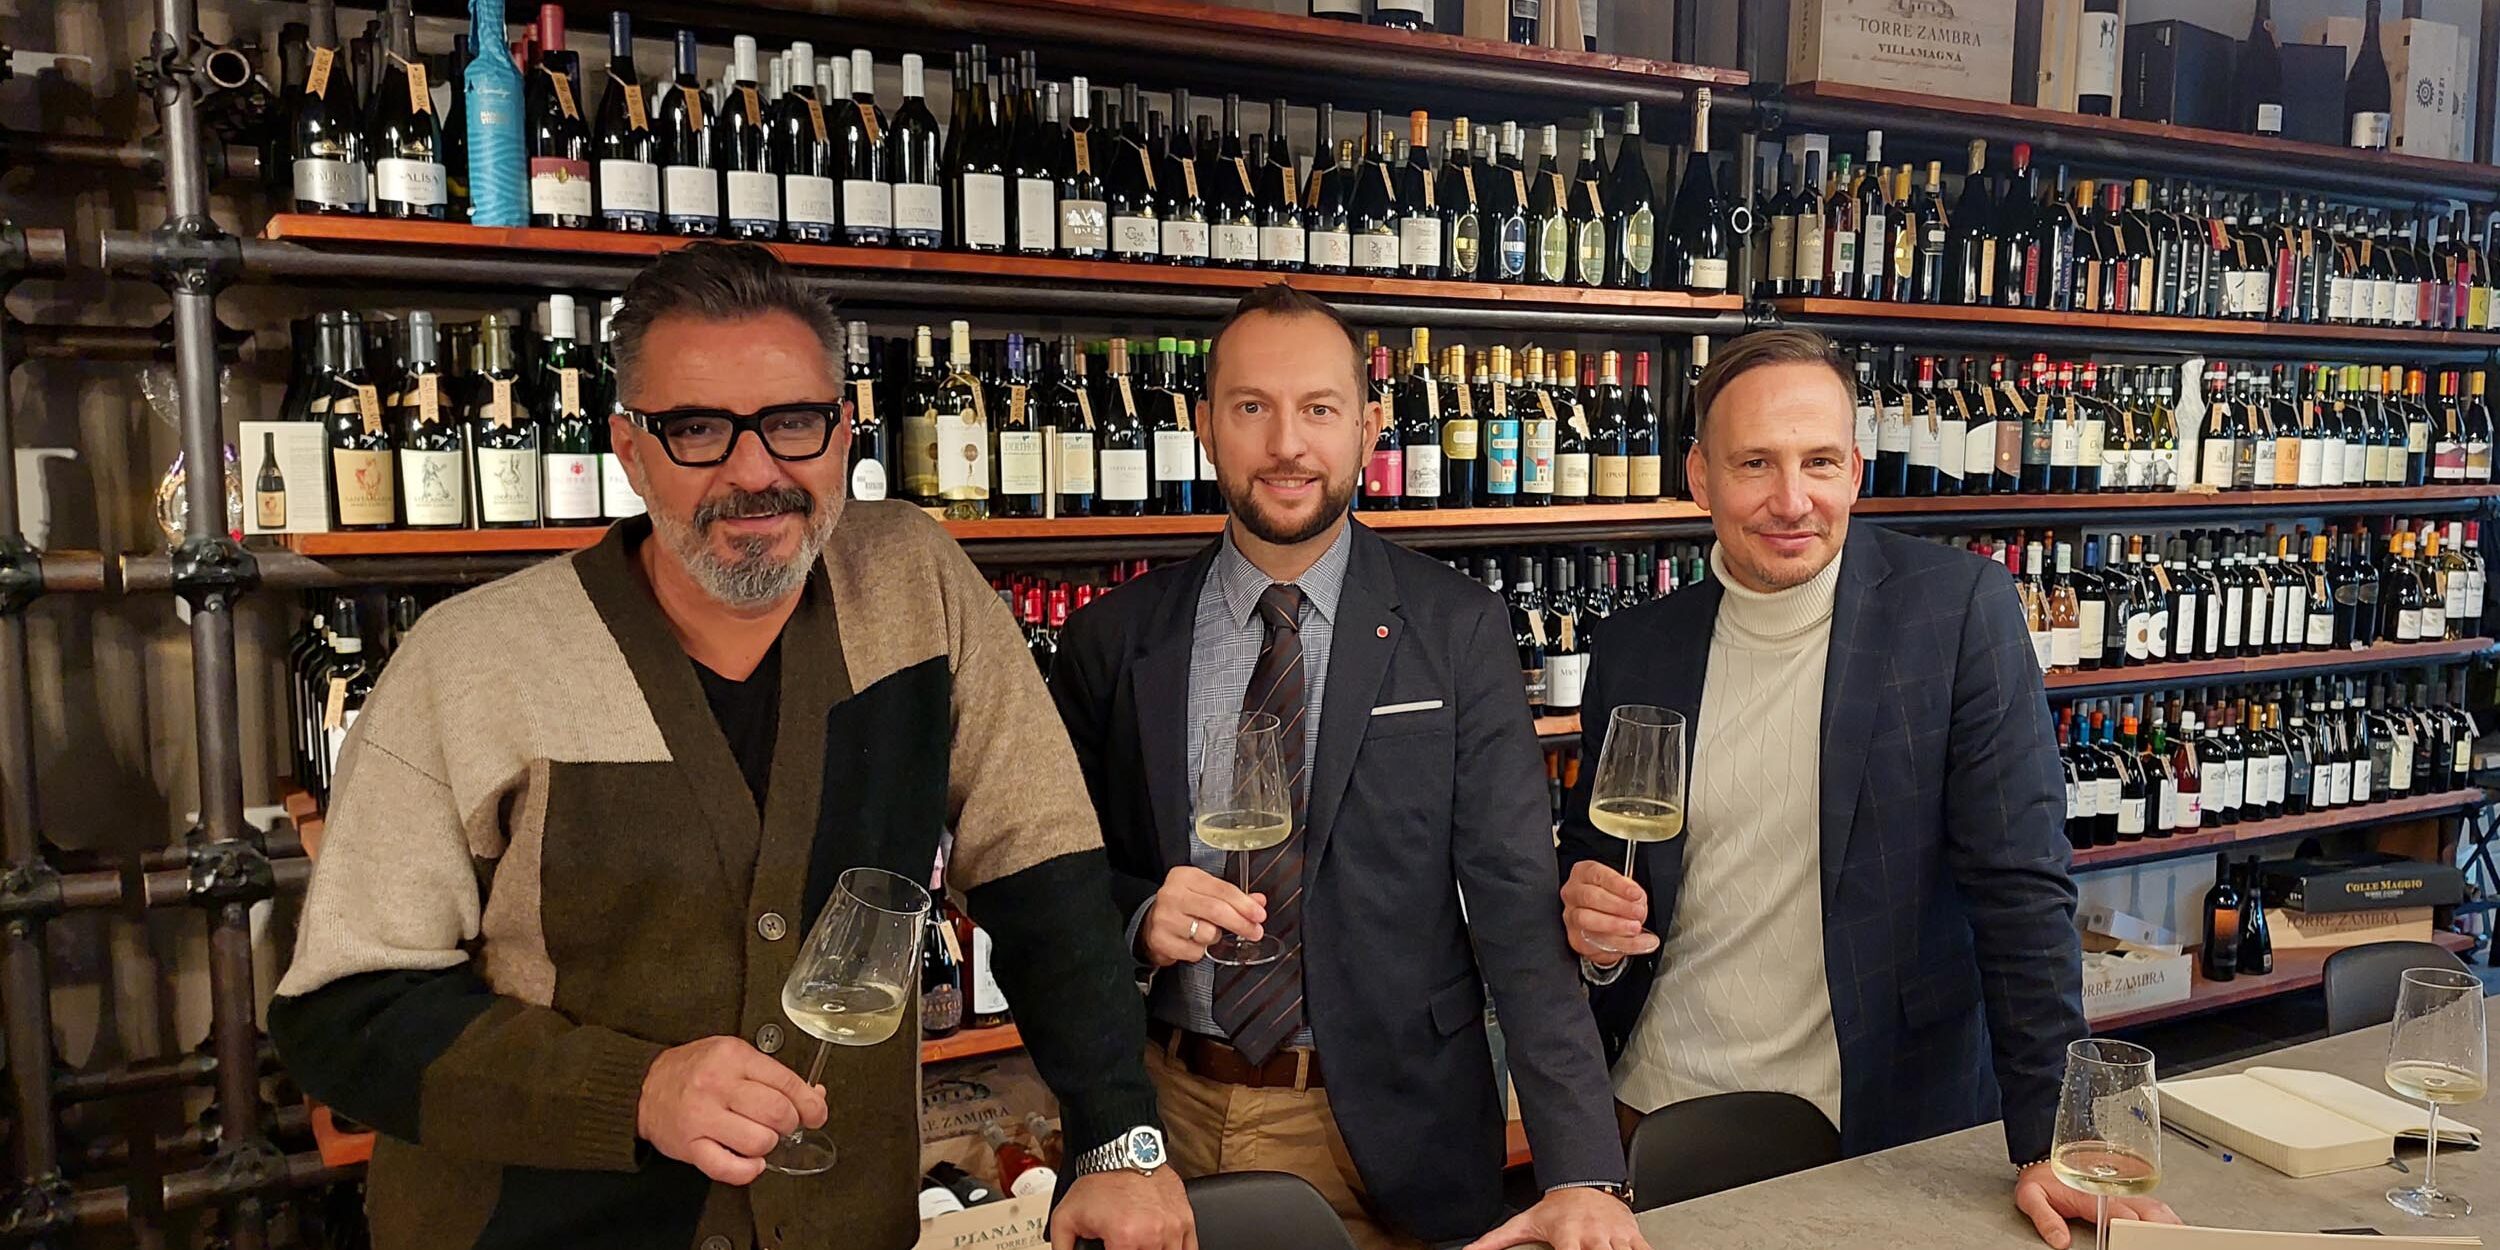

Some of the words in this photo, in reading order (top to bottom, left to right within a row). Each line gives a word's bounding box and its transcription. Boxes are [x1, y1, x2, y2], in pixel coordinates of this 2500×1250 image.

[1858, 17, 1914, 39] TORRE
[1916, 24, 1982, 48] ZAMBRA
[1878, 43, 1963, 63] VILLAMAGNA
[2437, 77, 2446, 113] TOZZI
[2345, 880, 2380, 894] COLLE
[2381, 879, 2423, 891] MAGGIO
[2286, 913, 2336, 929] TORRE
[2338, 911, 2401, 927] ZAMBRA
[2114, 970, 2165, 992] ZAMBRA
[941, 1105, 1010, 1129] ZAMBRA
[953, 1223, 1019, 1248] PIANA
[1026, 1217, 1045, 1232] M
[995, 1236, 1026, 1250] TORRE
